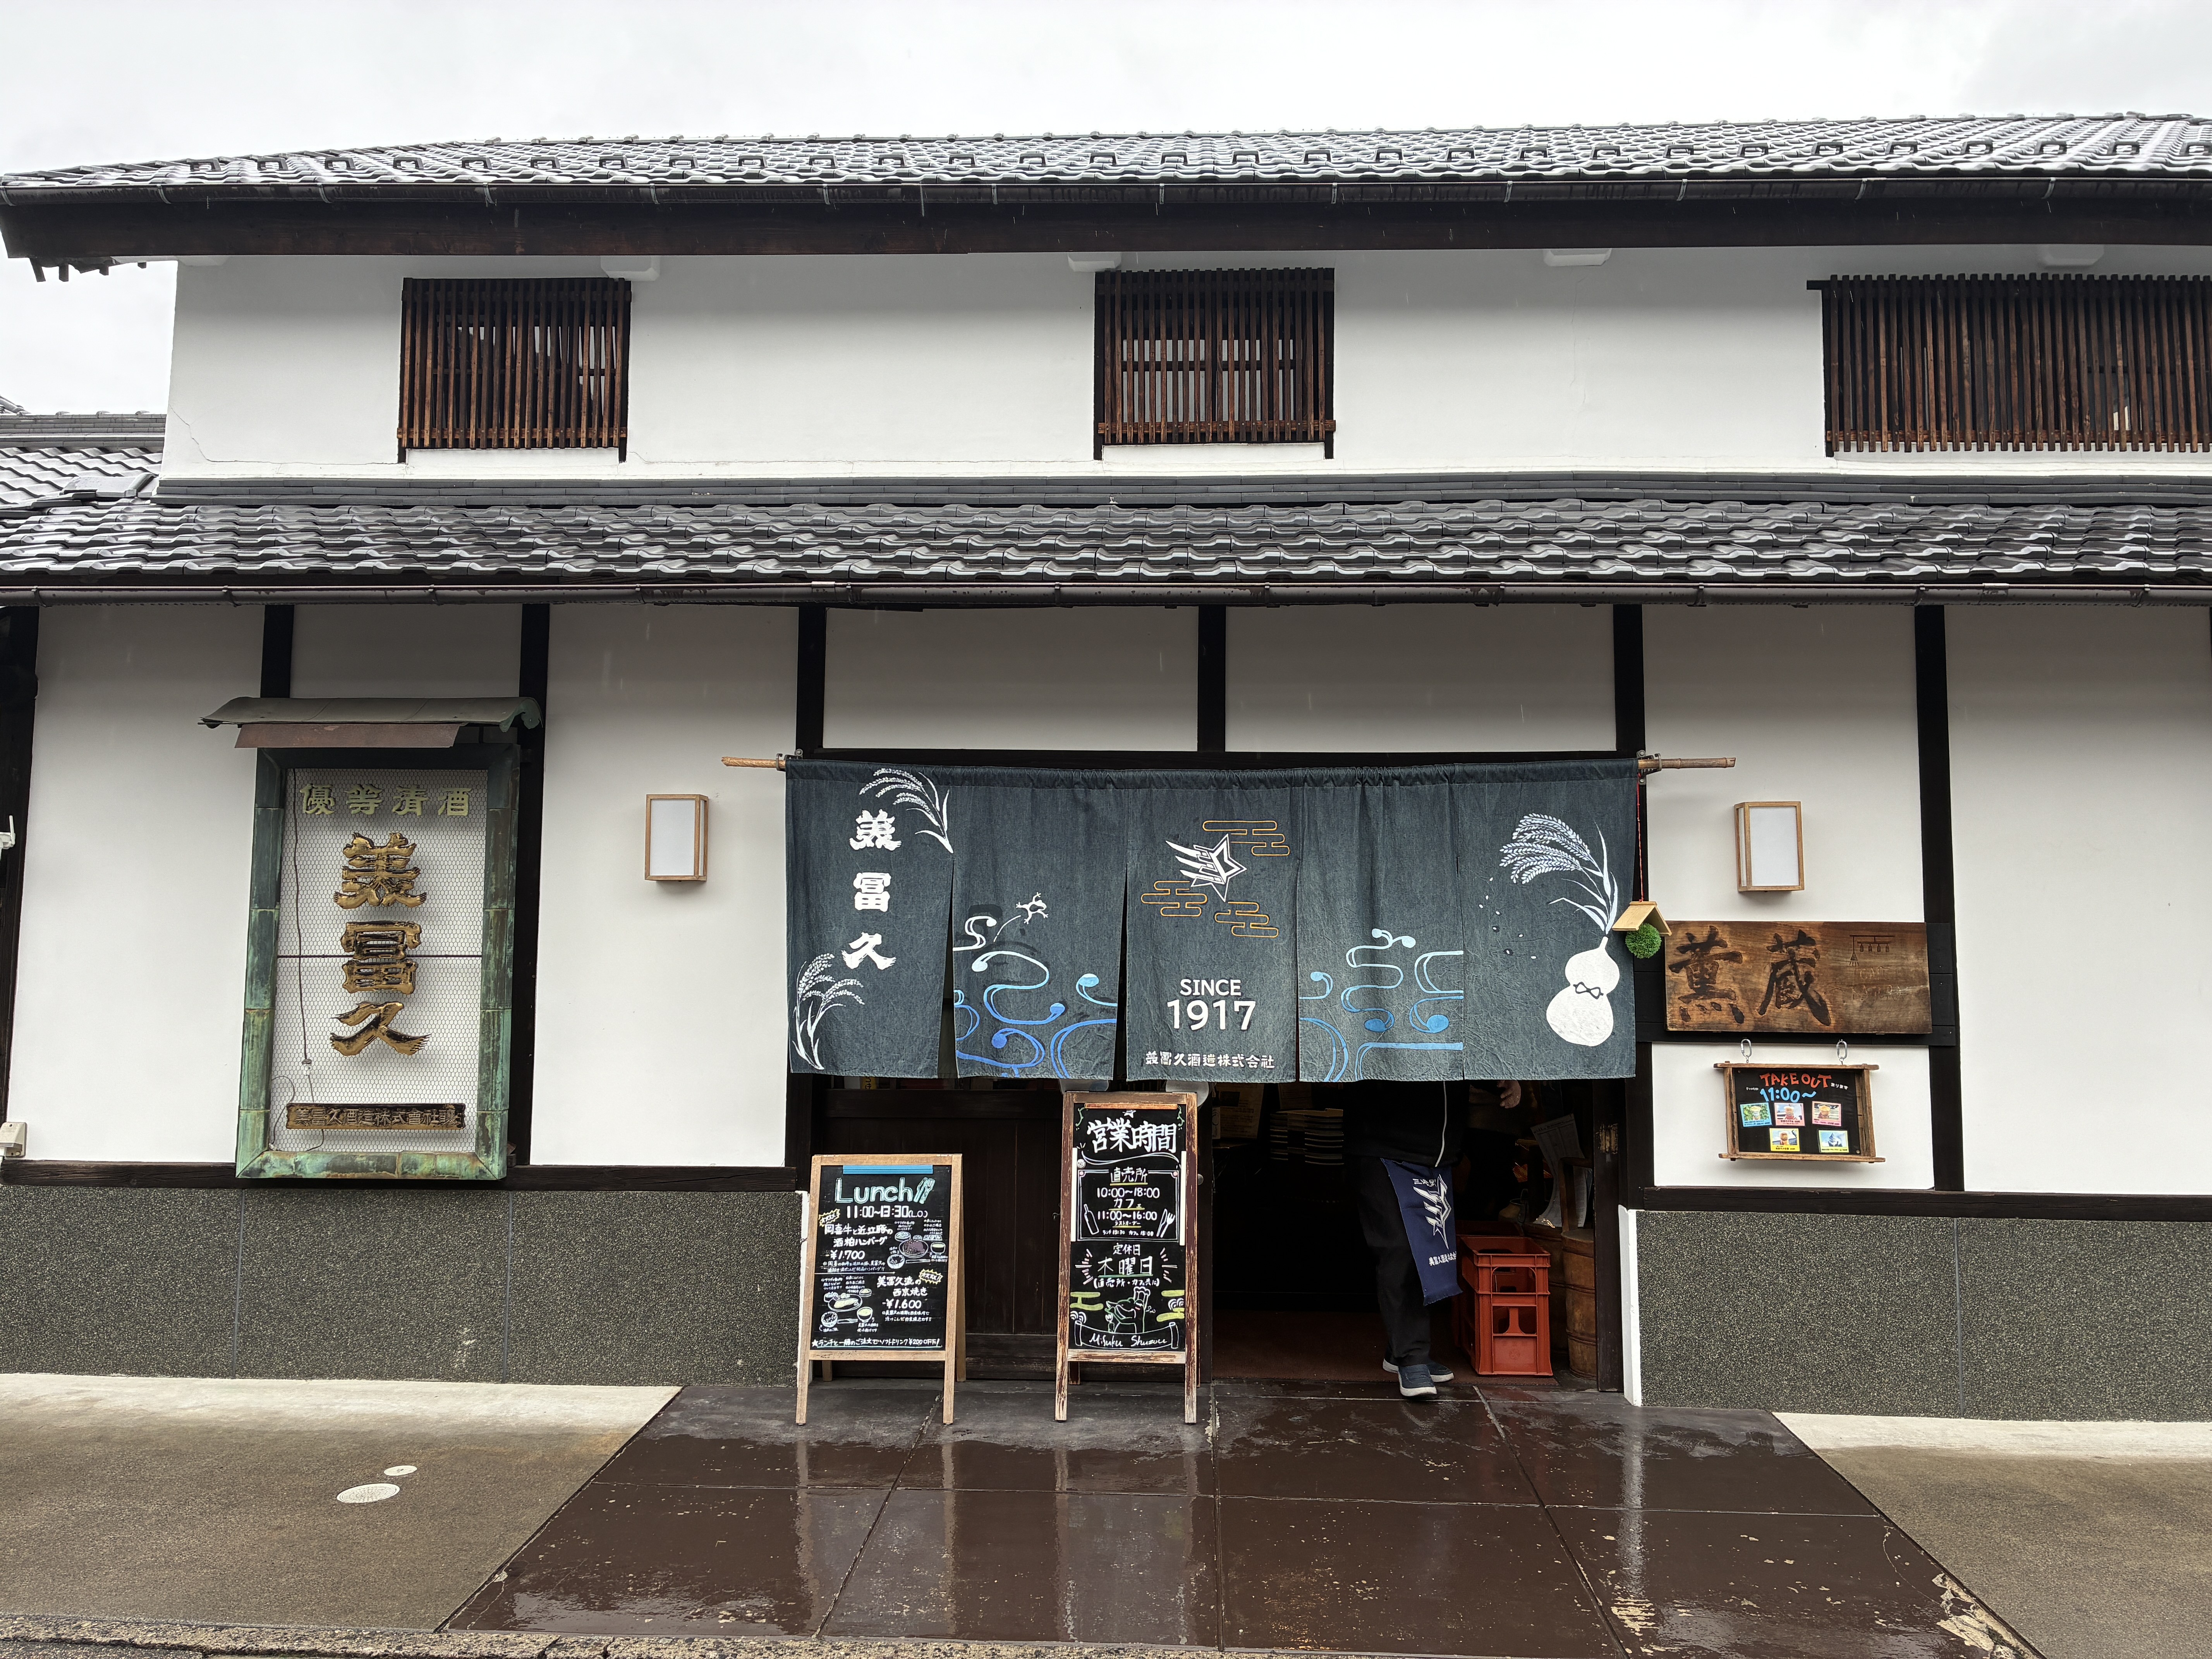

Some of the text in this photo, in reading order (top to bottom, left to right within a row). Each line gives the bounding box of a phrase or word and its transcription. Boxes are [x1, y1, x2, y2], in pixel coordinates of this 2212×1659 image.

[299, 783, 473, 817] 優等清酒
[1180, 979, 1242, 996] SINCE
[1167, 999, 1256, 1030] 1917
[1760, 1072, 1832, 1088] TAKE OUT
[1087, 1117, 1177, 1153] 営業時間
[1110, 1166, 1148, 1183] 直売所
[835, 1177, 914, 1204] Lunch
[1113, 1198, 1142, 1209] カフェ
[833, 1236, 888, 1248] 酒粕ハンバーグ
[1113, 1242, 1140, 1256] 定休日
[1097, 1256, 1153, 1275] 木曜日
[892, 1286, 928, 1297] 西京焼き
